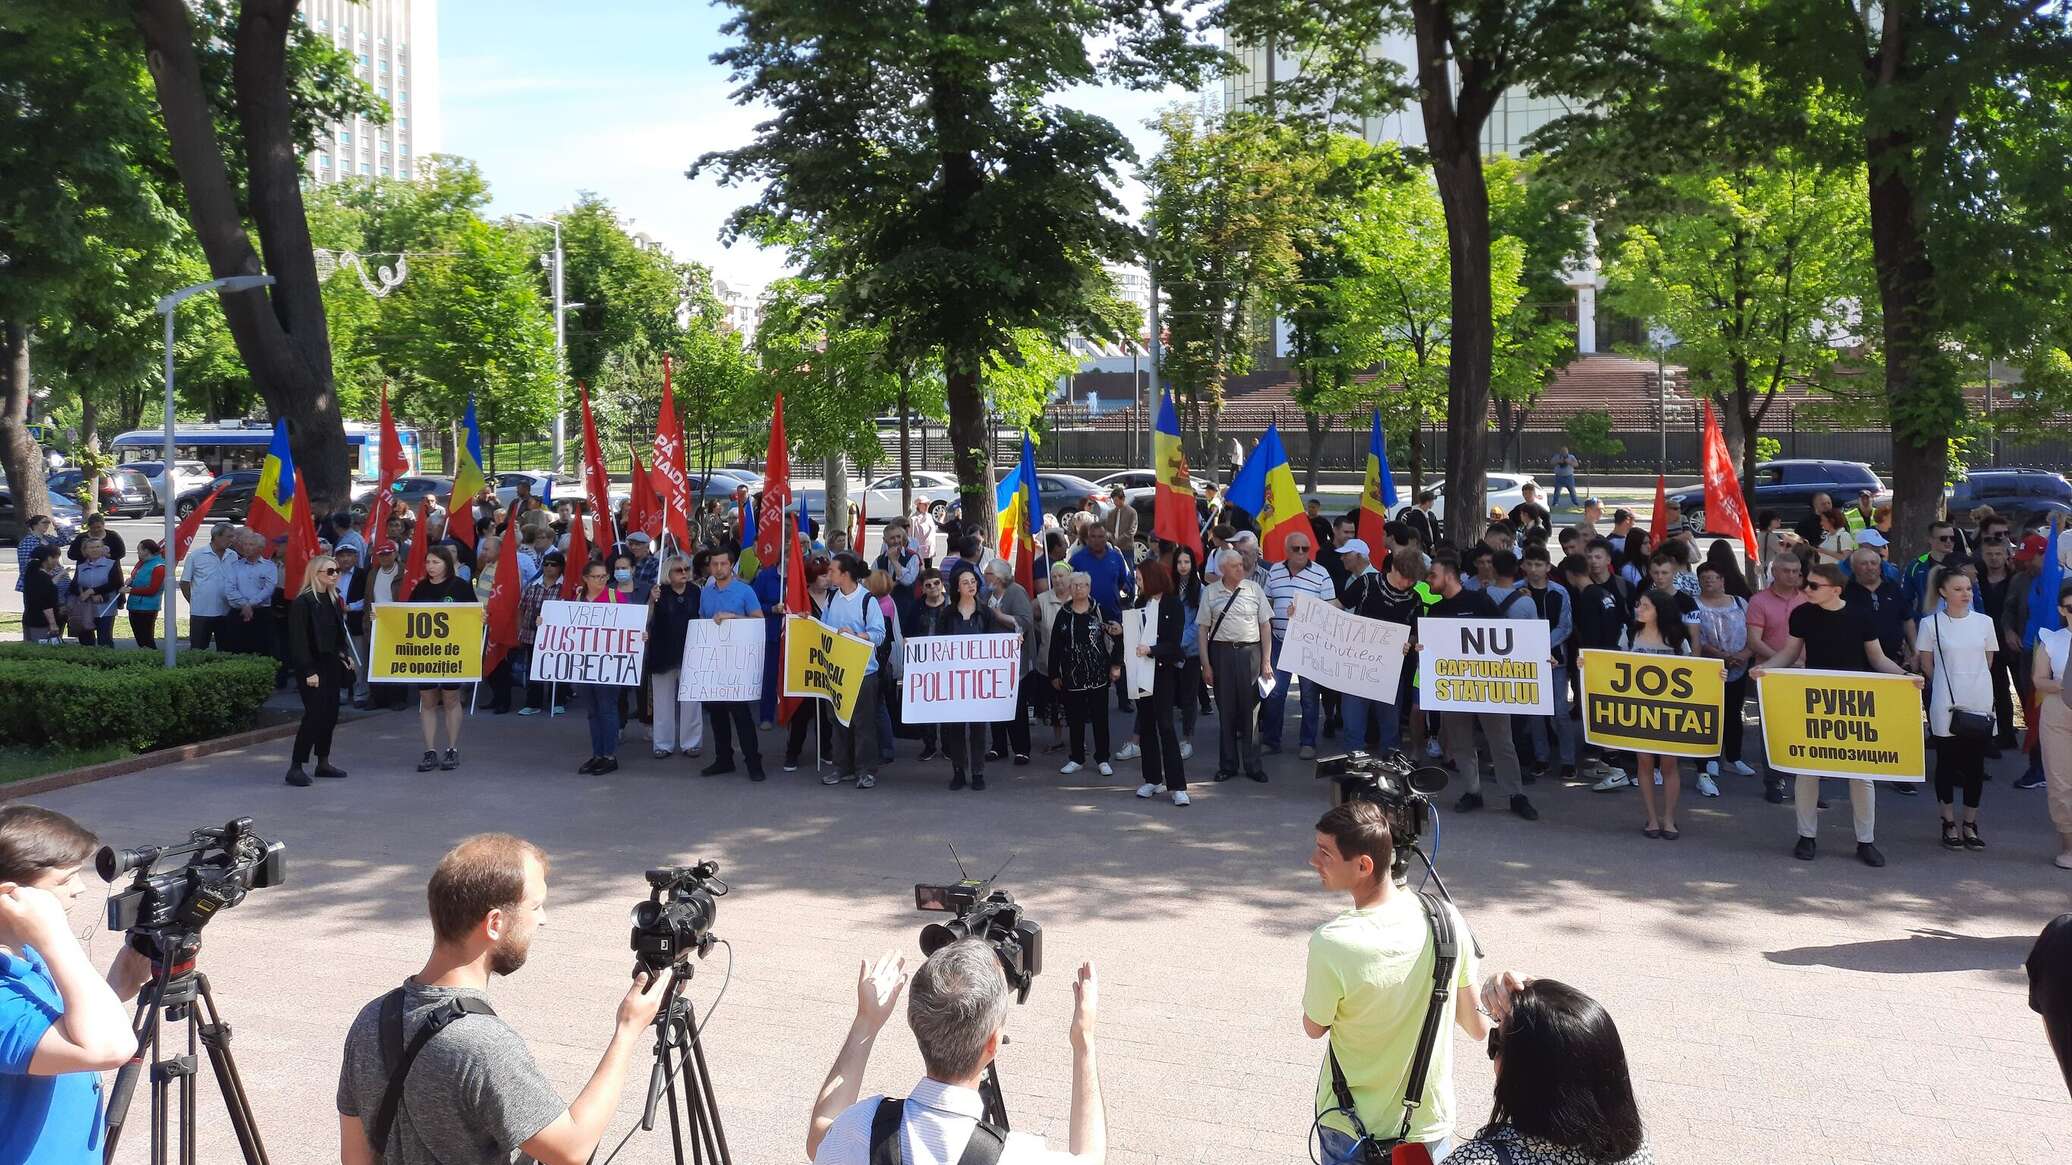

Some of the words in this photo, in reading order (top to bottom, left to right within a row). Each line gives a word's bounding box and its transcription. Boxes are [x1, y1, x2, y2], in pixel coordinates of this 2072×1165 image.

[405, 612, 449, 639] JOS
[568, 606, 619, 626] VREM
[445, 643, 460, 656] de
[906, 643, 927, 664] NU
[1460, 627, 1514, 655] NU
[391, 662, 407, 674] pe
[1435, 658, 1538, 679] CAPTURĂRII
[1610, 663, 1693, 698] JOS
[1435, 678, 1540, 705] STATULUI
[1805, 688, 1875, 717] РУКИ
[1595, 701, 1711, 735] HUNTA!
[1806, 718, 1878, 742] ПРОЧЬ
